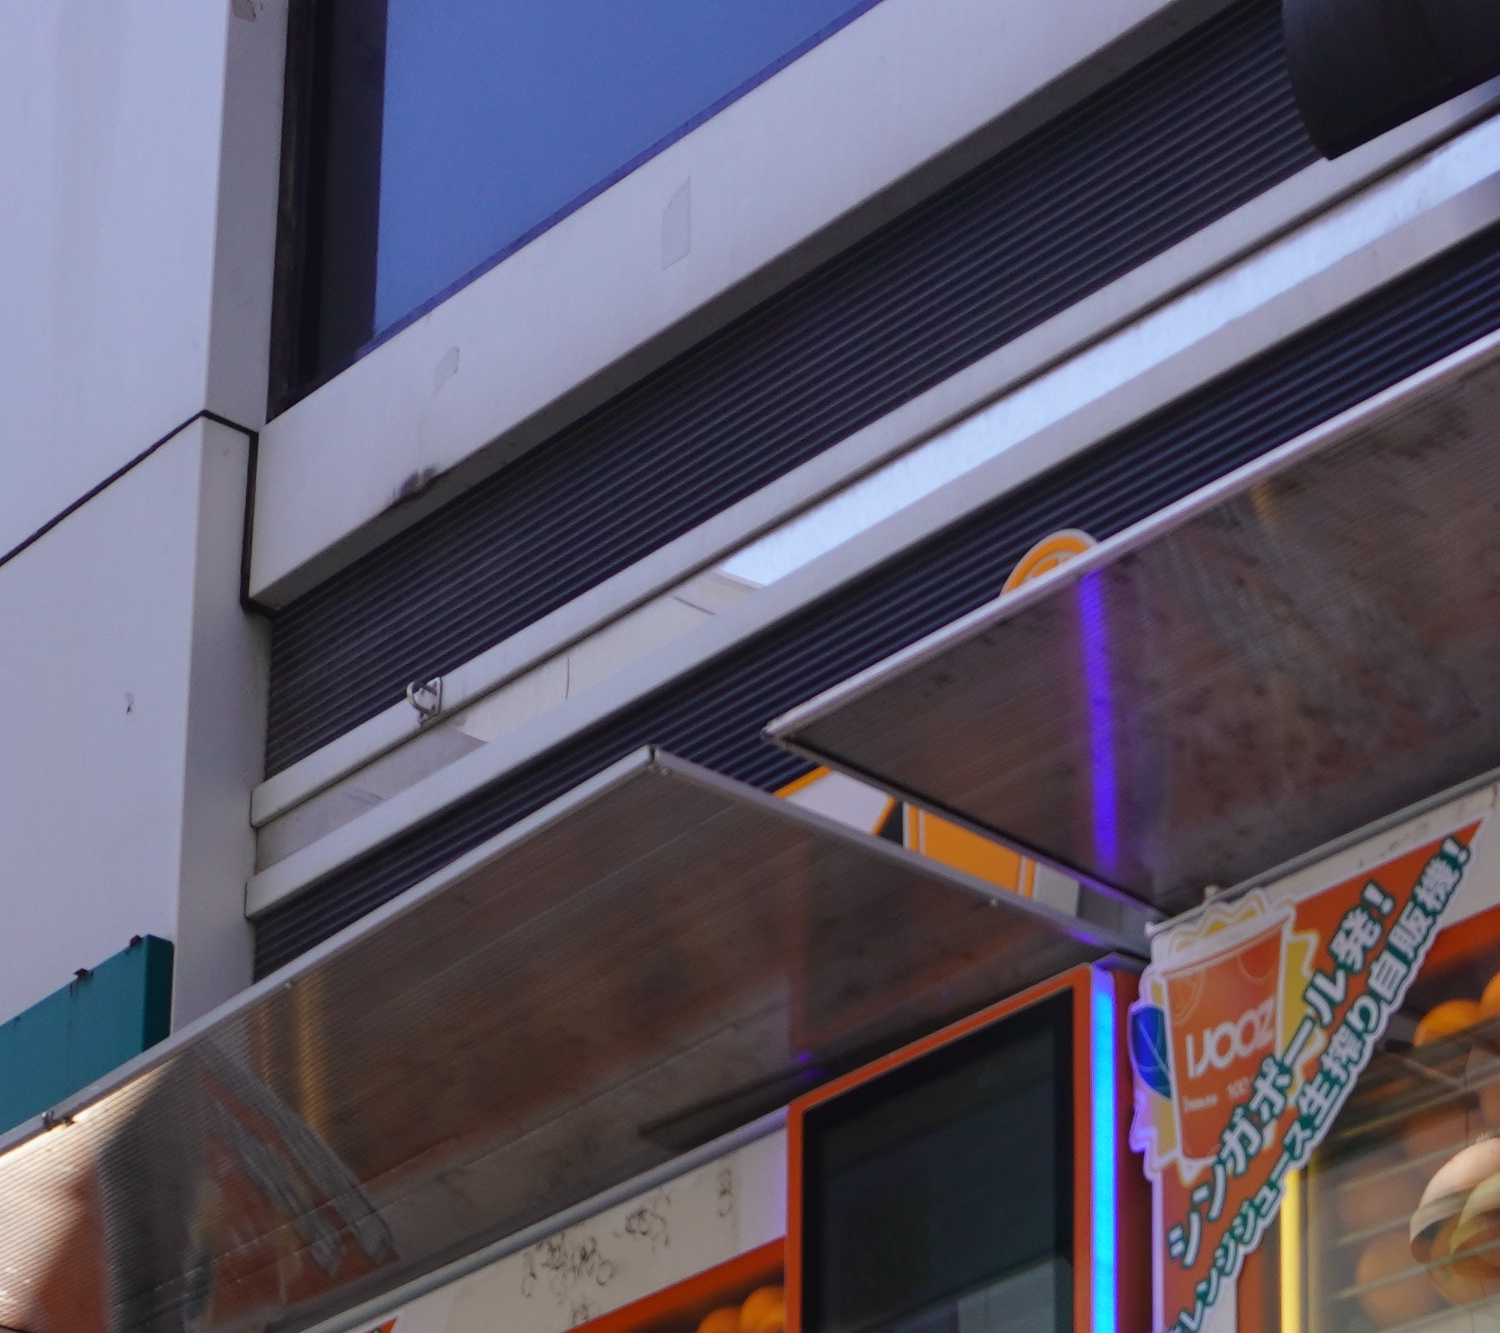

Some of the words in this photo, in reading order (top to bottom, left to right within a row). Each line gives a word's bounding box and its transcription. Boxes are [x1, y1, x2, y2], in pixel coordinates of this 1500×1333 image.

[1167, 880, 1395, 1270] シンガポール発!
